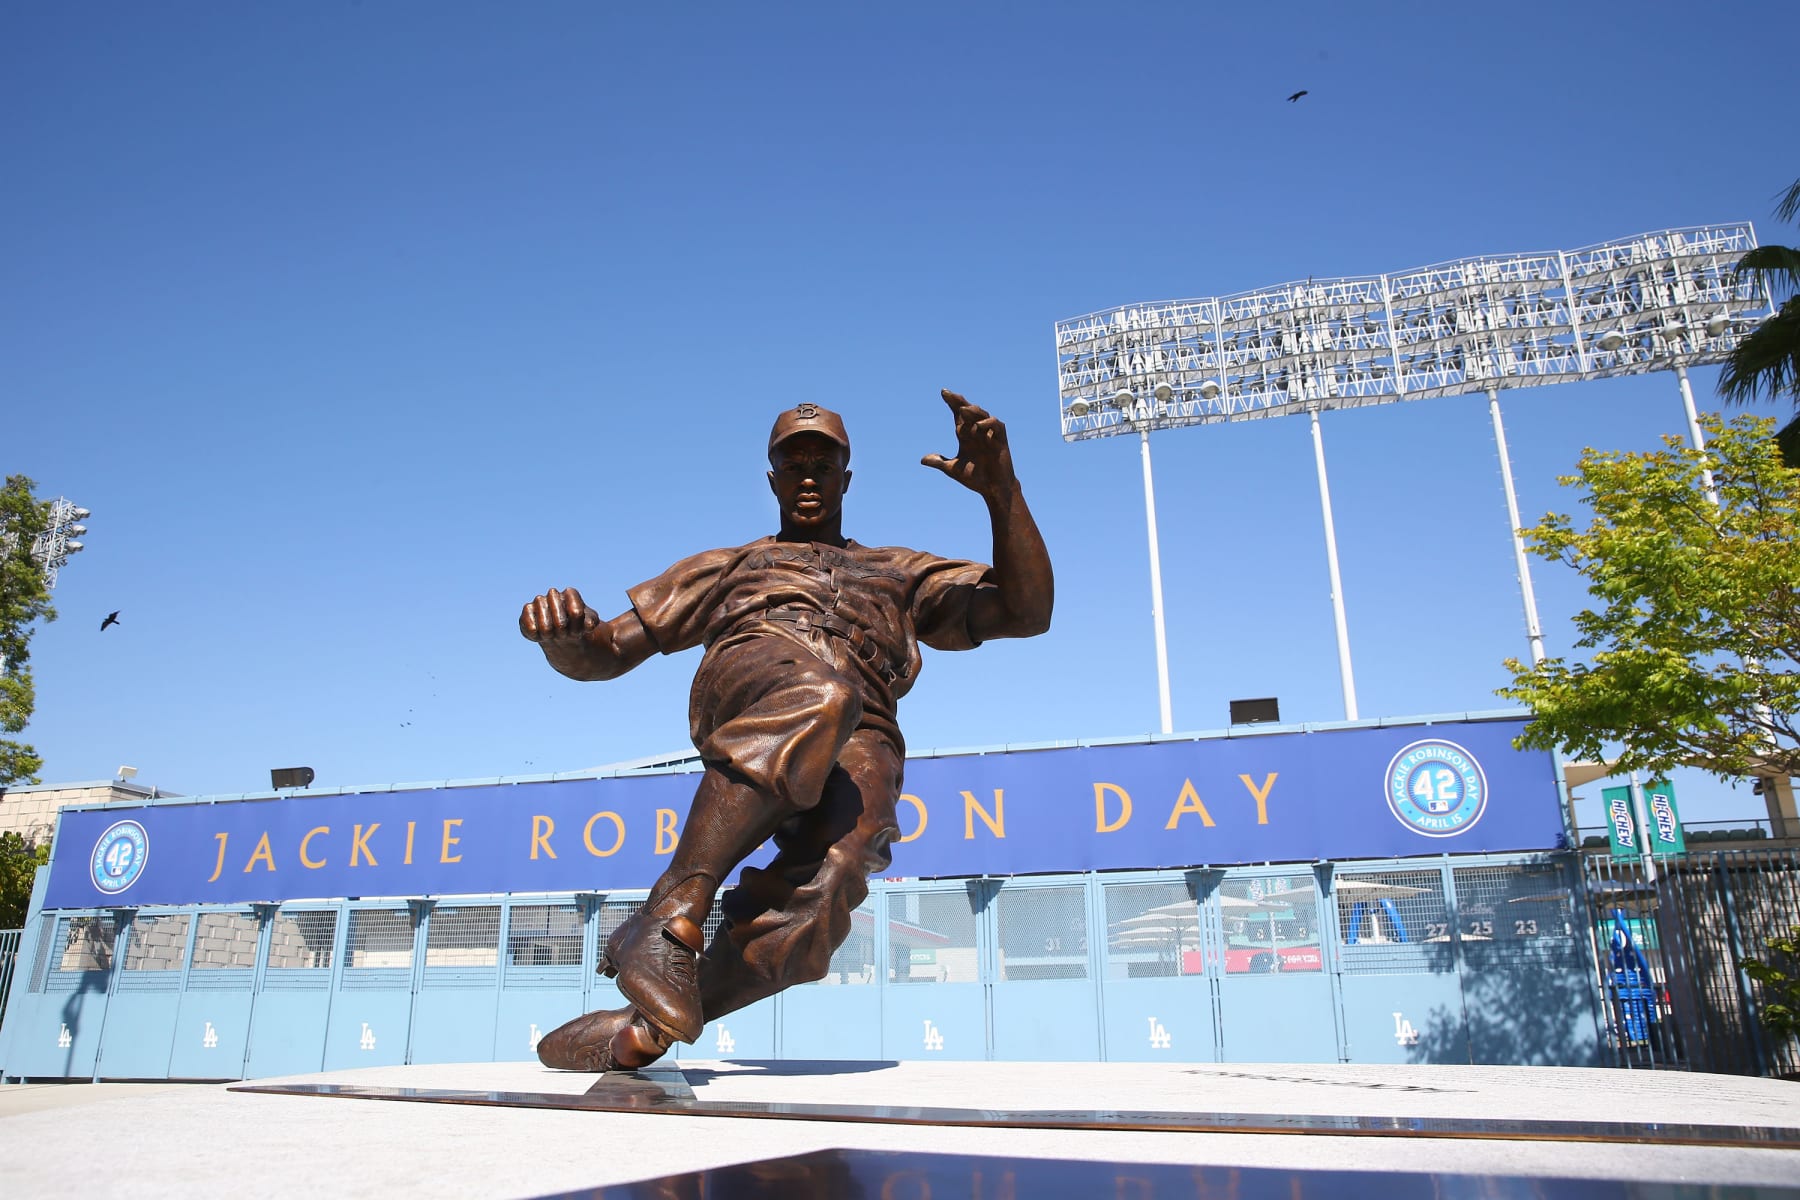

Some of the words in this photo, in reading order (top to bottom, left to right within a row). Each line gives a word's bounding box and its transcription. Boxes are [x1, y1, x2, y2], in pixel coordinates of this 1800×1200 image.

[796, 402, 820, 420] B
[1394, 763, 1410, 804] JACKIE
[1408, 748, 1470, 773] ROBINSON
[1465, 775, 1478, 800] DAY
[1413, 769, 1458, 800] 42
[208, 819, 463, 882] JACKIE
[530, 789, 1005, 860] ROBON
[1093, 772, 1278, 833] DAY
[1416, 816, 1449, 828] APRIL
[1451, 813, 1463, 824] 15
[106, 843, 132, 867] 42
[1425, 923, 1448, 937] 27
[1470, 921, 1493, 935] 25
[1515, 920, 1537, 934] 23
[58, 1023, 72, 1047] LA
[203, 1022, 218, 1047] LA
[360, 1022, 376, 1049] LA
[716, 1024, 735, 1052] LA
[923, 1020, 943, 1050] LA
[1148, 1017, 1170, 1048] LA
[1392, 1012, 1418, 1045] LA
